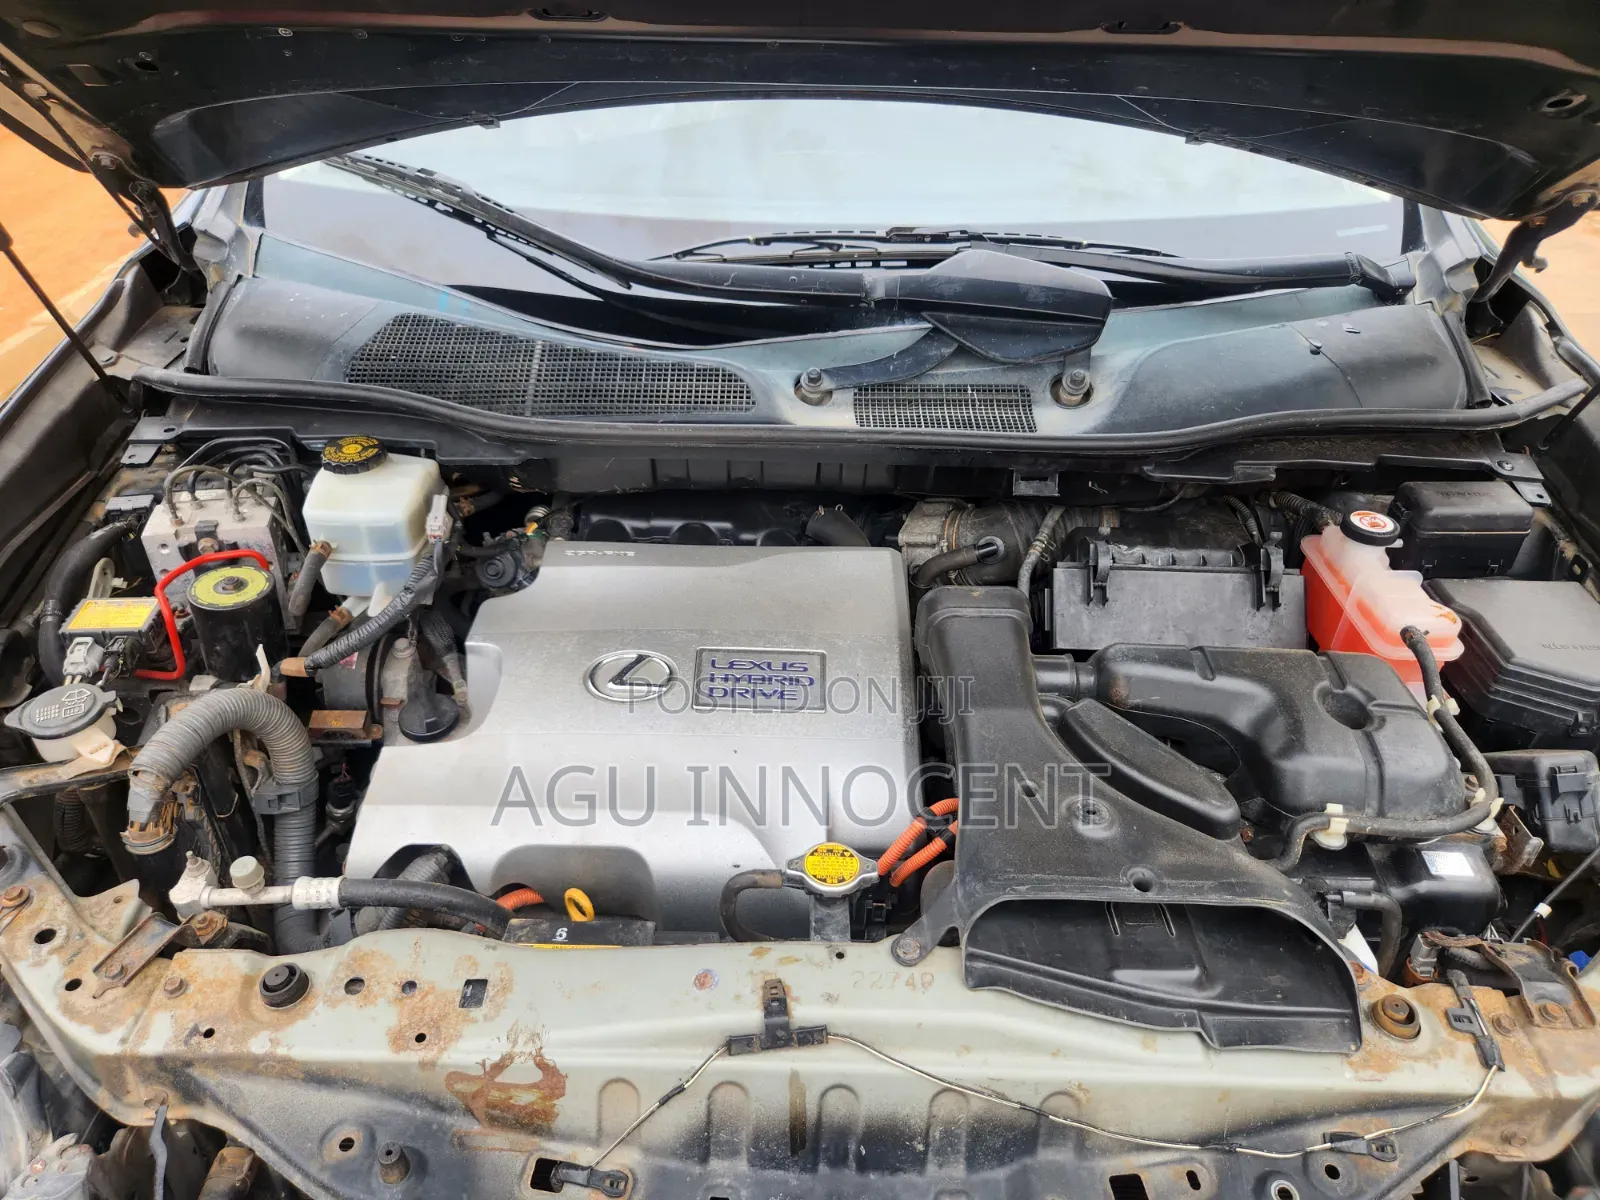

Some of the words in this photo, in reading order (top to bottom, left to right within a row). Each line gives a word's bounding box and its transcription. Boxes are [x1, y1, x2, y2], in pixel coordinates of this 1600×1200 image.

[711, 657, 809, 673] LEXUS
[709, 672, 815, 686] HYBRID
[708, 686, 798, 700] DRIVE
[555, 927, 568, 941] 6
